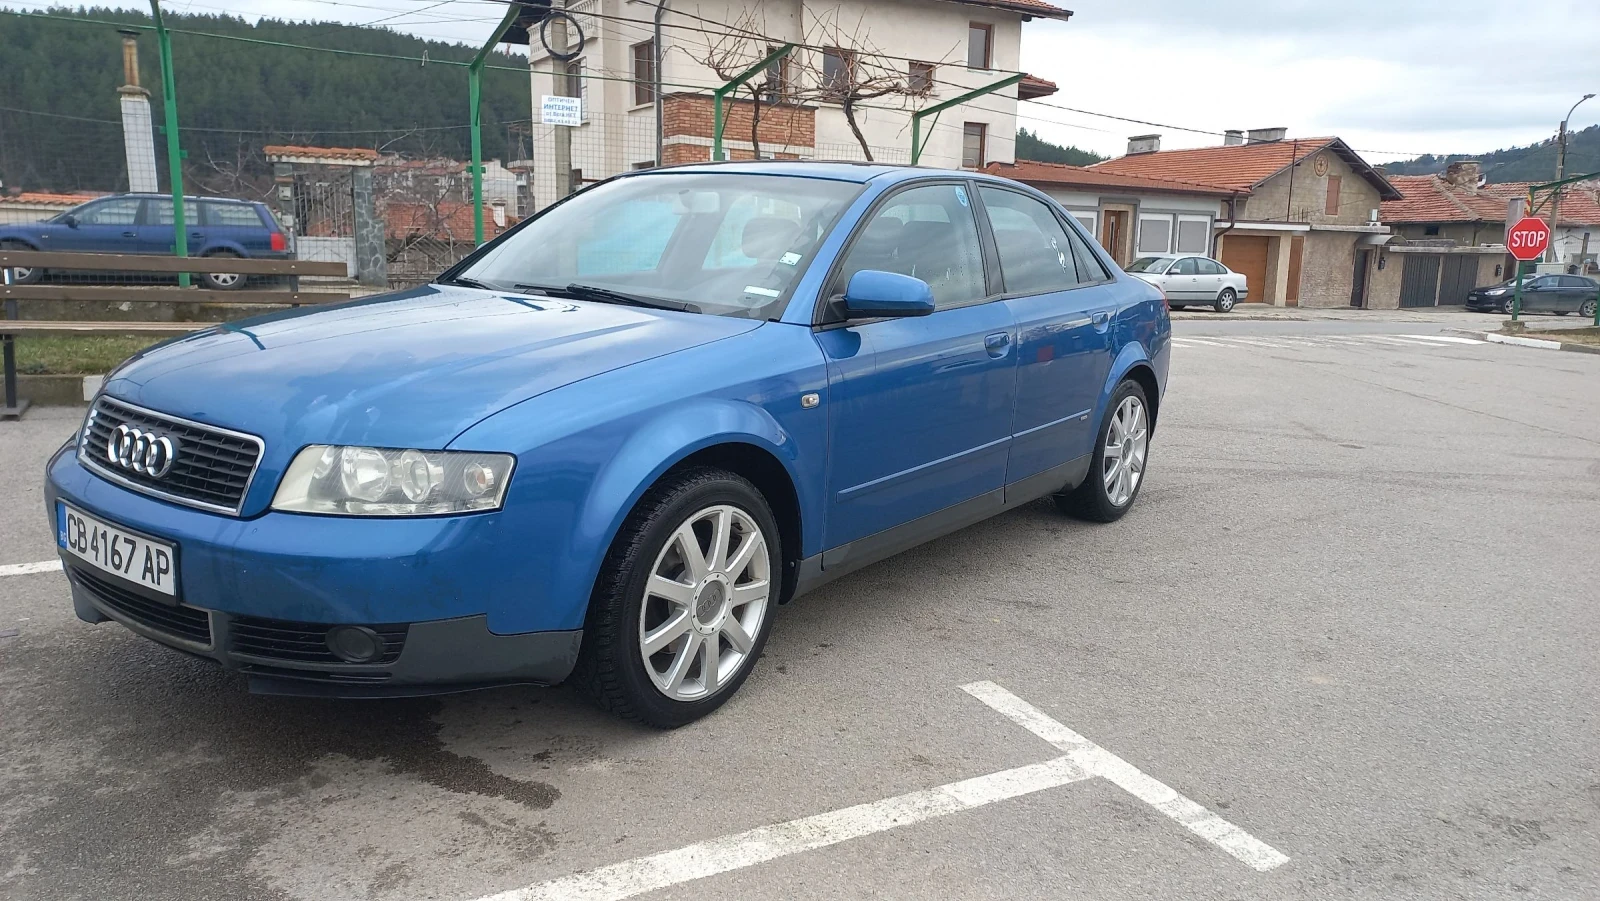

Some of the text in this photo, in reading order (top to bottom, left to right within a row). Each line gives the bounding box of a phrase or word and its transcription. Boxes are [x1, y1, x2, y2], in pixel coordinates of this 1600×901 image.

[1512, 231, 1546, 247] STOP
[68, 514, 169, 586] CB 4167 AP
